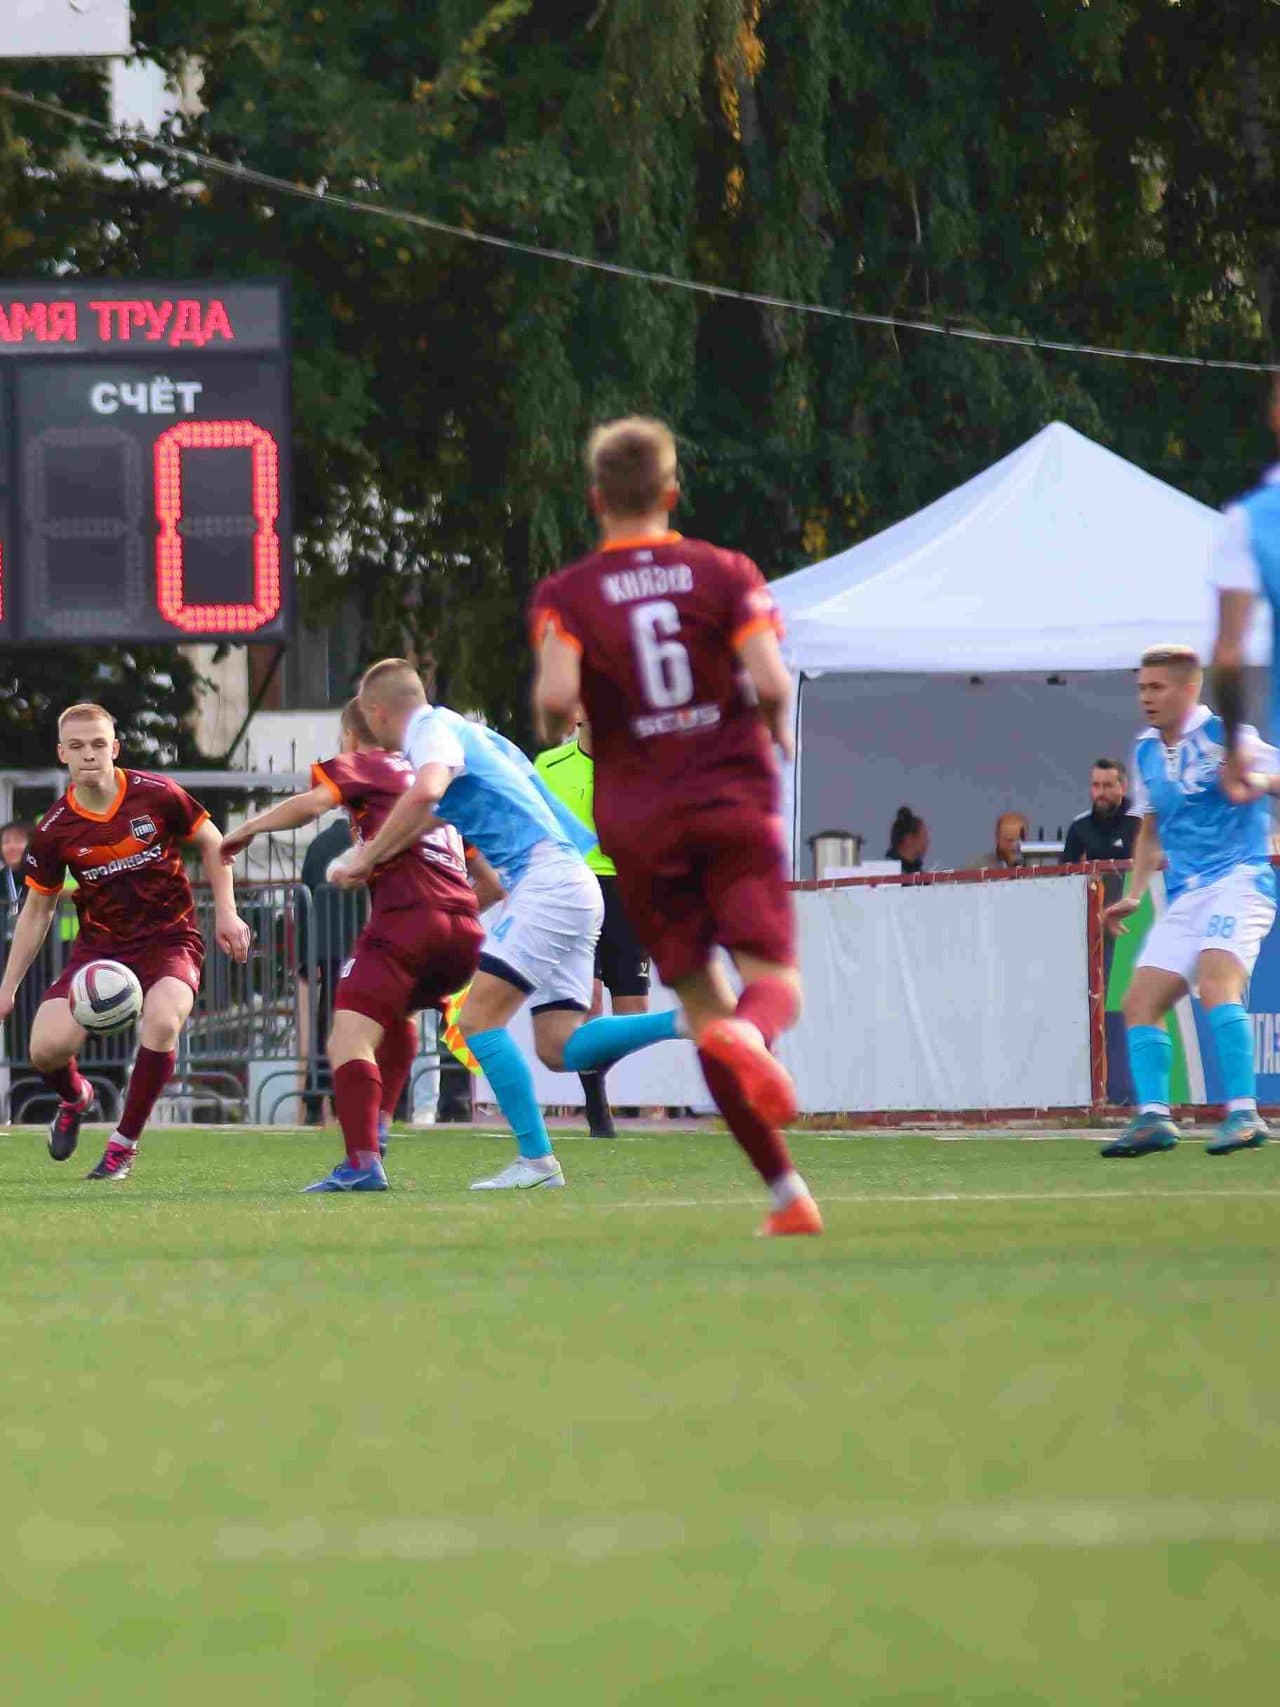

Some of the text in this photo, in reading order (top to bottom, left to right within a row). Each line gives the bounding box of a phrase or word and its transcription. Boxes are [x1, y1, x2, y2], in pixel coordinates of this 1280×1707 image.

[88, 300, 235, 348] ТРУДА
[90, 376, 203, 415] СЧЁТ
[153, 420, 281, 633] 0
[630, 599, 695, 708] 6
